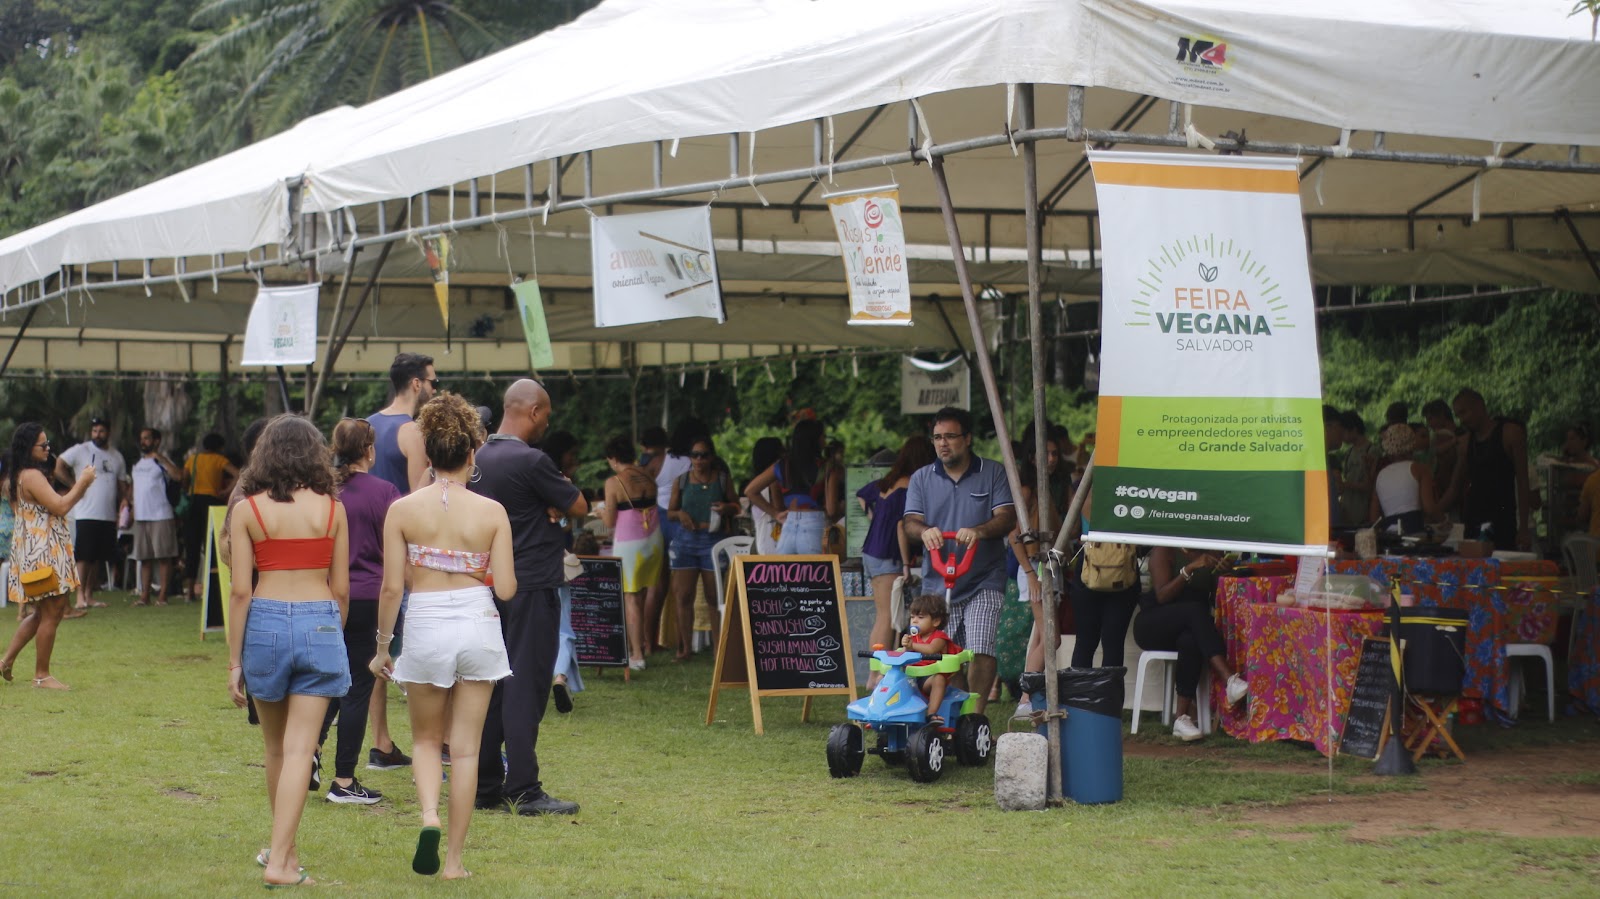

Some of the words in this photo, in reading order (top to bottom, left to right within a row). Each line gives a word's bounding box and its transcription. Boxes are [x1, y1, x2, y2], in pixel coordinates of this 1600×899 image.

[610, 248, 657, 270] amana
[612, 275, 645, 288] oriental
[1174, 287, 1250, 311] FEIRA
[1156, 312, 1271, 336] VEGANA
[1176, 338, 1253, 352] SALVADOR
[1162, 414, 1239, 426] Protagonizada
[1242, 416, 1258, 425] por
[1261, 414, 1303, 424] ativistas
[1137, 429, 1144, 437] e
[1147, 428, 1253, 439] empreendedores
[1256, 429, 1304, 439] veganos
[1178, 441, 1195, 452] da
[1199, 441, 1247, 452] Grande
[1250, 441, 1304, 452] Salvador
[1115, 486, 1197, 502] #GoVegan
[1148, 509, 1252, 523] /feiraveganasalvador
[747, 563, 831, 584] amana
[752, 599, 783, 615] SUSHI
[755, 618, 806, 635] SANDUSHI
[758, 640, 787, 655] SUSHI
[787, 639, 818, 654] AMANA
[760, 657, 779, 672] HOT
[780, 657, 816, 671] TEMAKI
